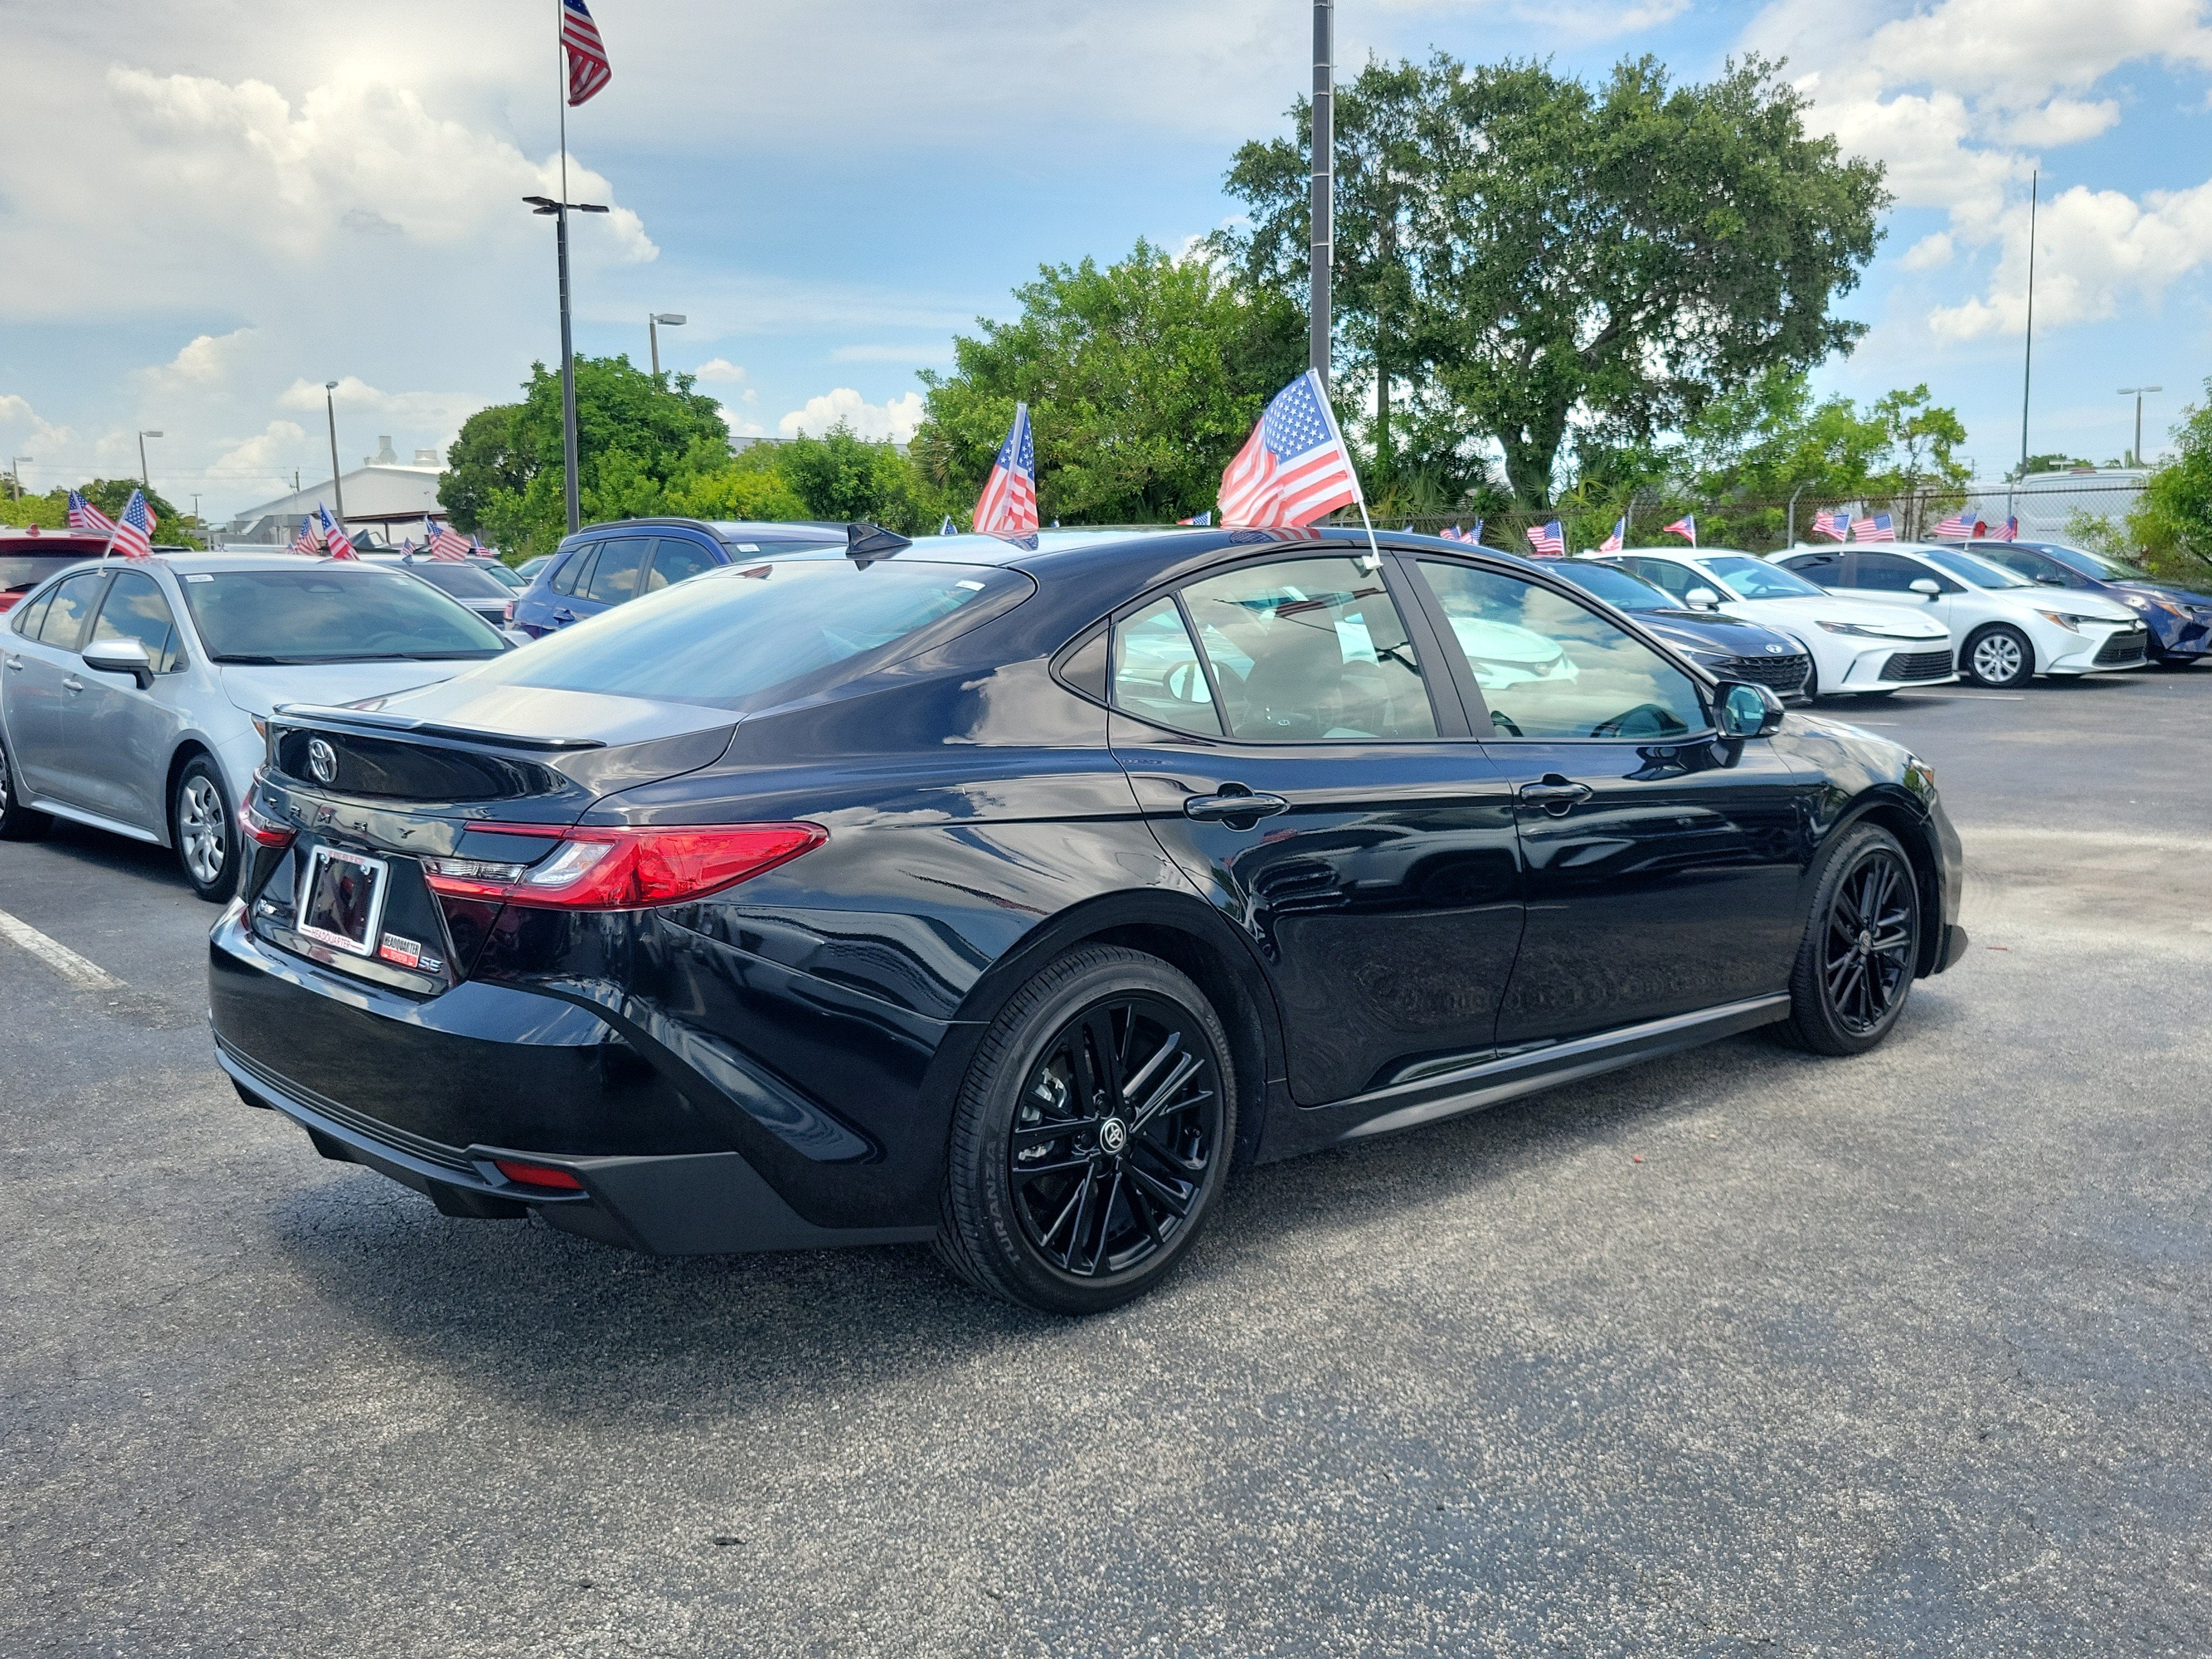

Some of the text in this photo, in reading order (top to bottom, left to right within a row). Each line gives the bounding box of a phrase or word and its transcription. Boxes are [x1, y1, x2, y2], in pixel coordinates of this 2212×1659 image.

[266, 797, 416, 839] CAMRY
[311, 928, 351, 948] HEADQUARTER
[385, 935, 420, 956] HEADQUARTER
[418, 955, 443, 973] SE
[985, 1141, 1021, 1266] TURANZA
